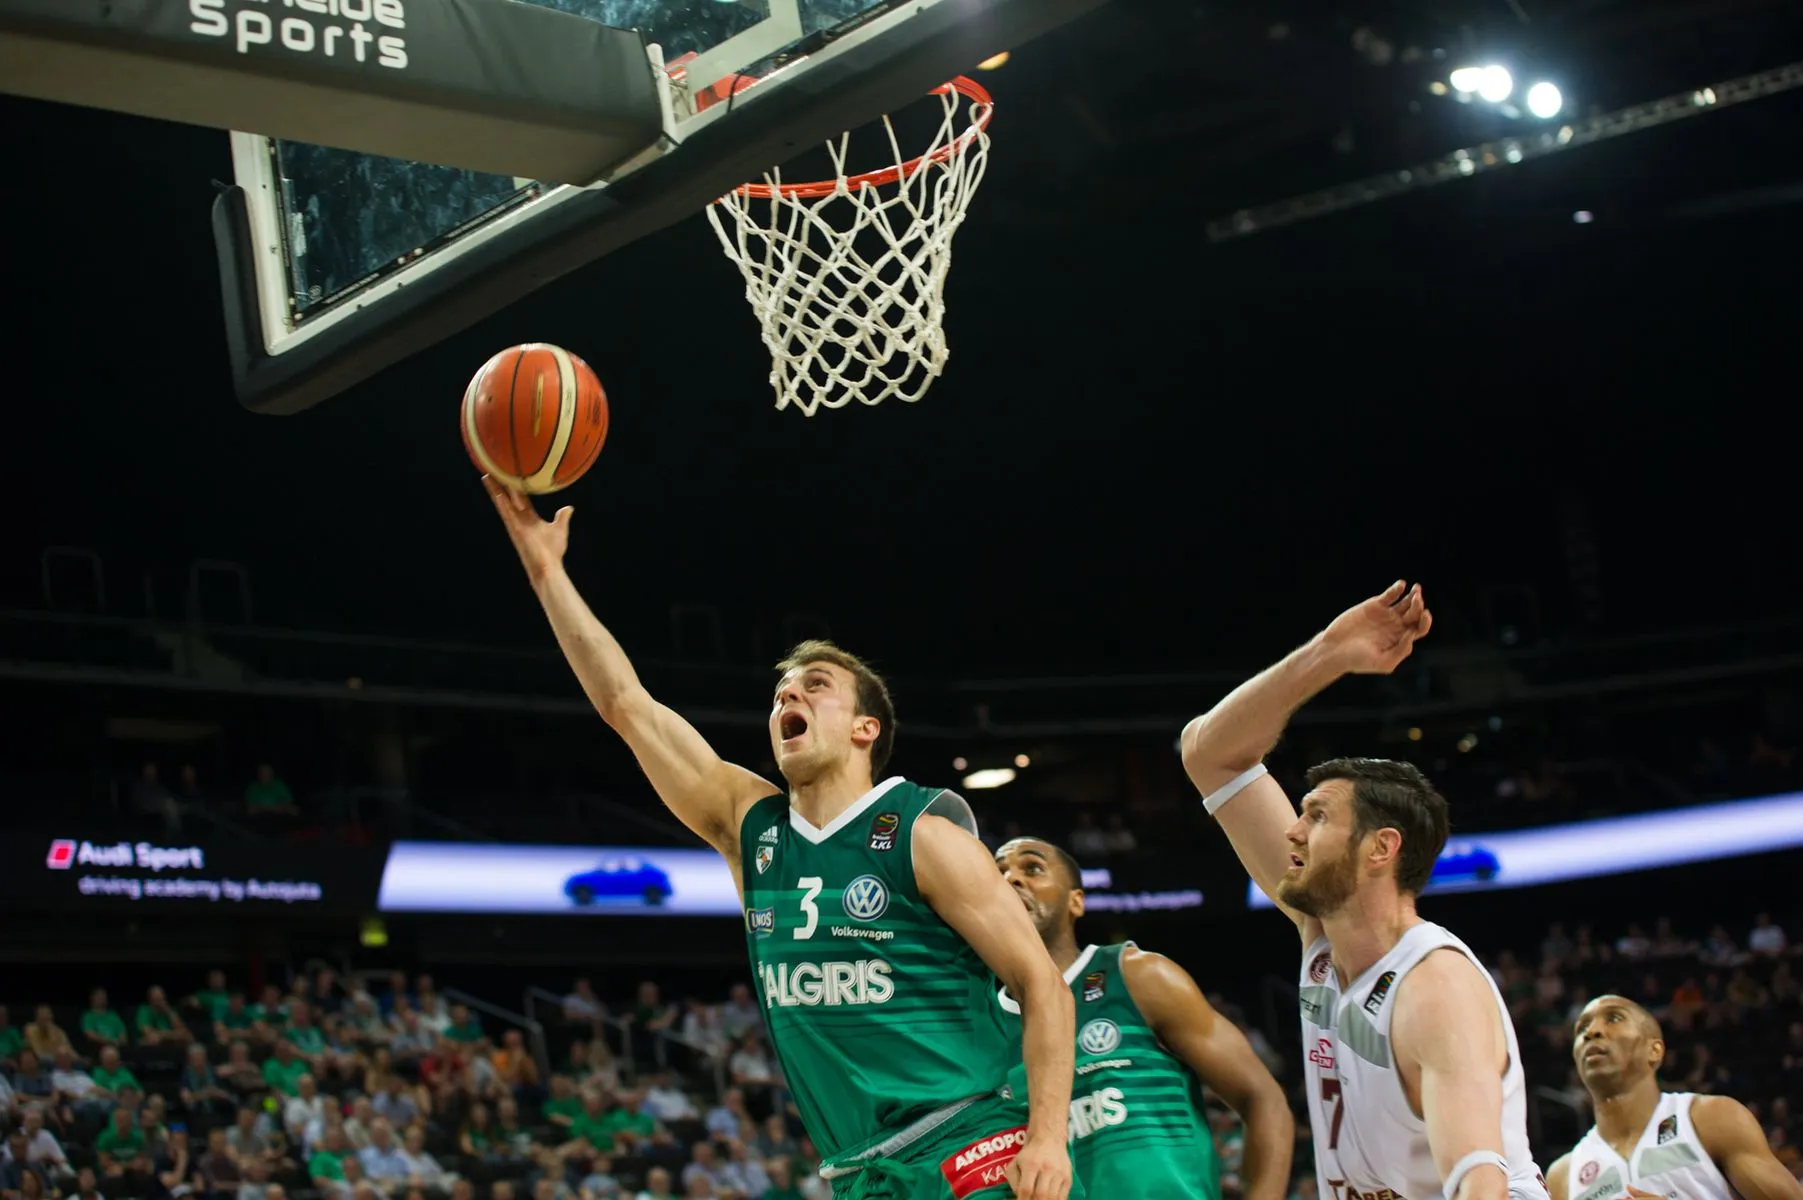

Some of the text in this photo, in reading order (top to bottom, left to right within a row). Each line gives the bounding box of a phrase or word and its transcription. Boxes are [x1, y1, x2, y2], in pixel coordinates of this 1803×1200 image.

[78, 840, 204, 872] Audi Sport
[870, 840, 892, 850] LKL
[793, 876, 823, 940] 3
[831, 926, 894, 941] Volkswagen
[1322, 1078, 1344, 1149] 7
[955, 1130, 1027, 1172] AKROPO
[981, 1163, 1008, 1184] KA
